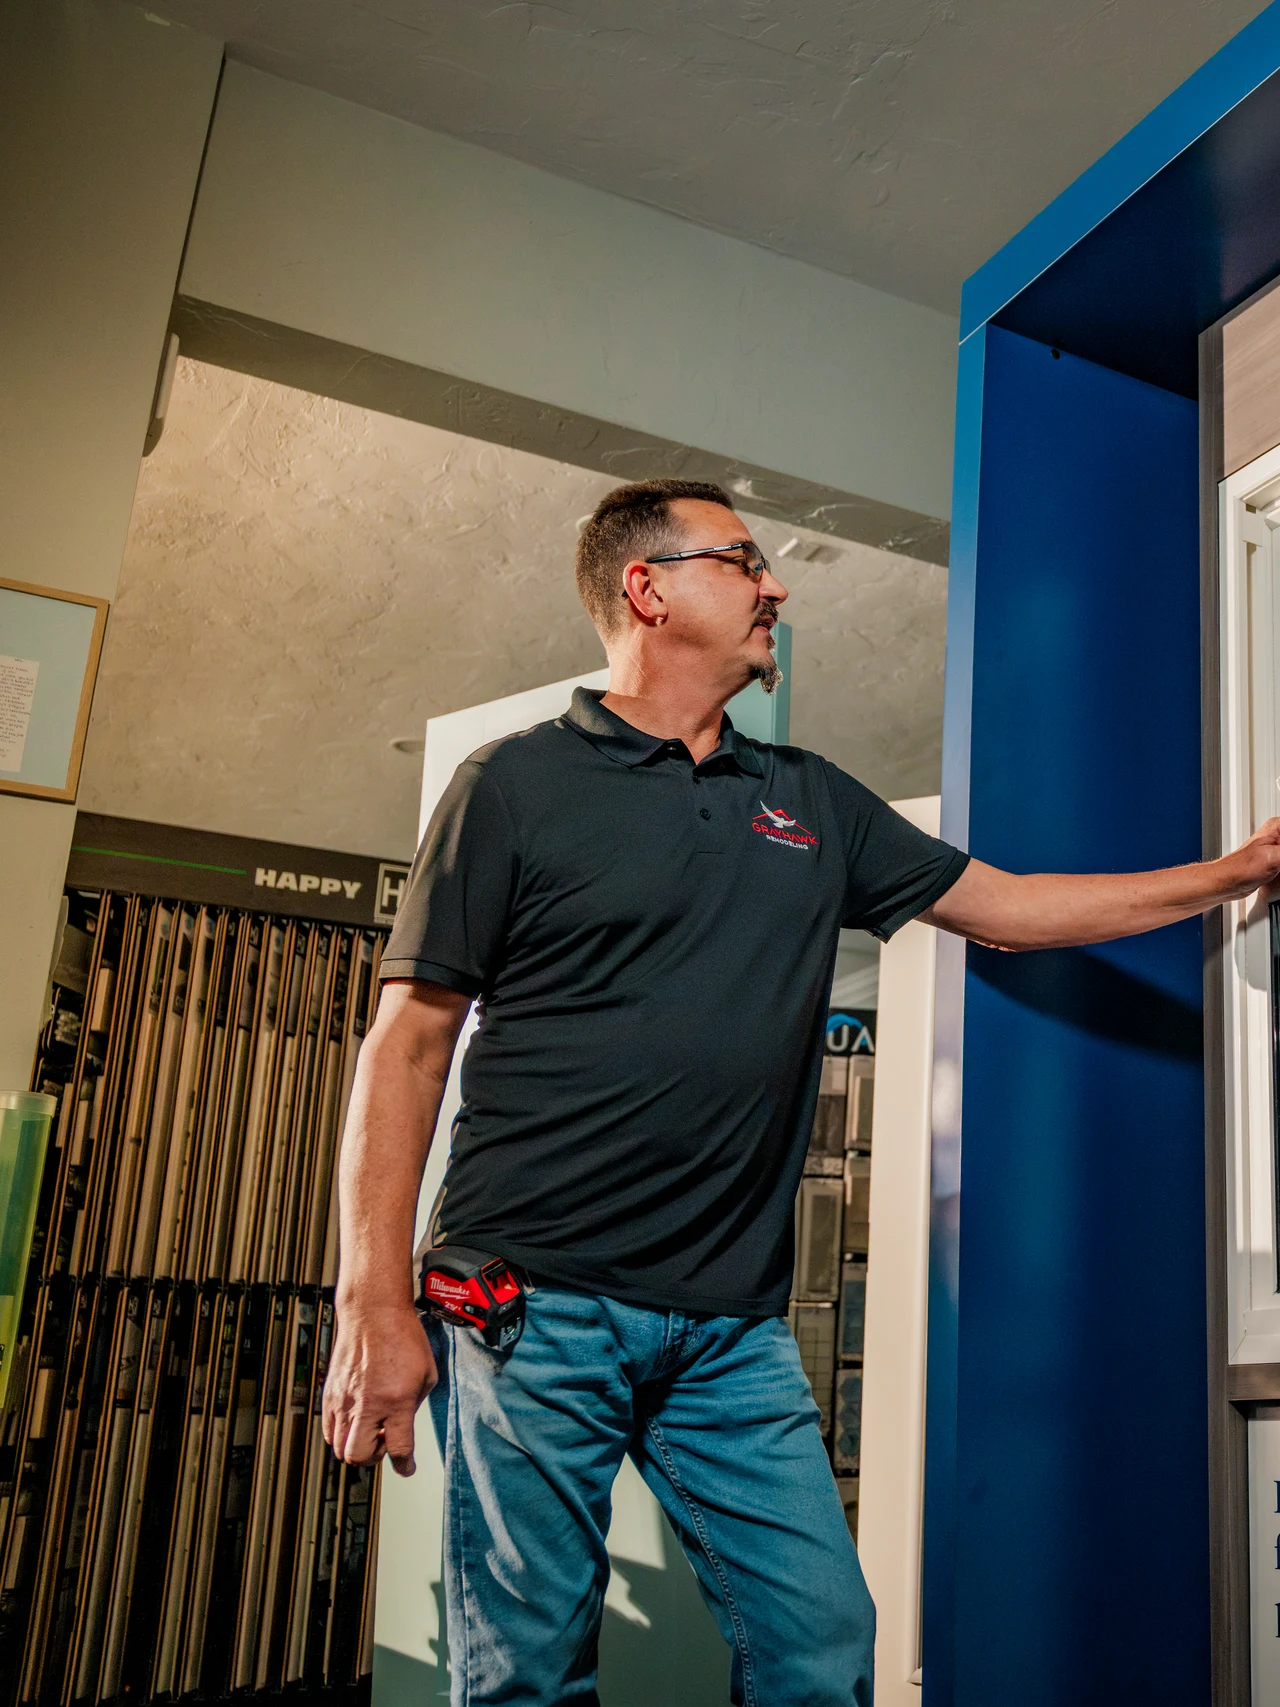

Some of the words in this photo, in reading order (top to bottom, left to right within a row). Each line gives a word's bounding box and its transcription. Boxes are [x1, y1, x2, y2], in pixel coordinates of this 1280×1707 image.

[751, 822, 819, 845] GRAYHAWK
[766, 834, 808, 850] REMODELING
[254, 867, 363, 899] HAPPY
[430, 1277, 470, 1296] Milwaukee
